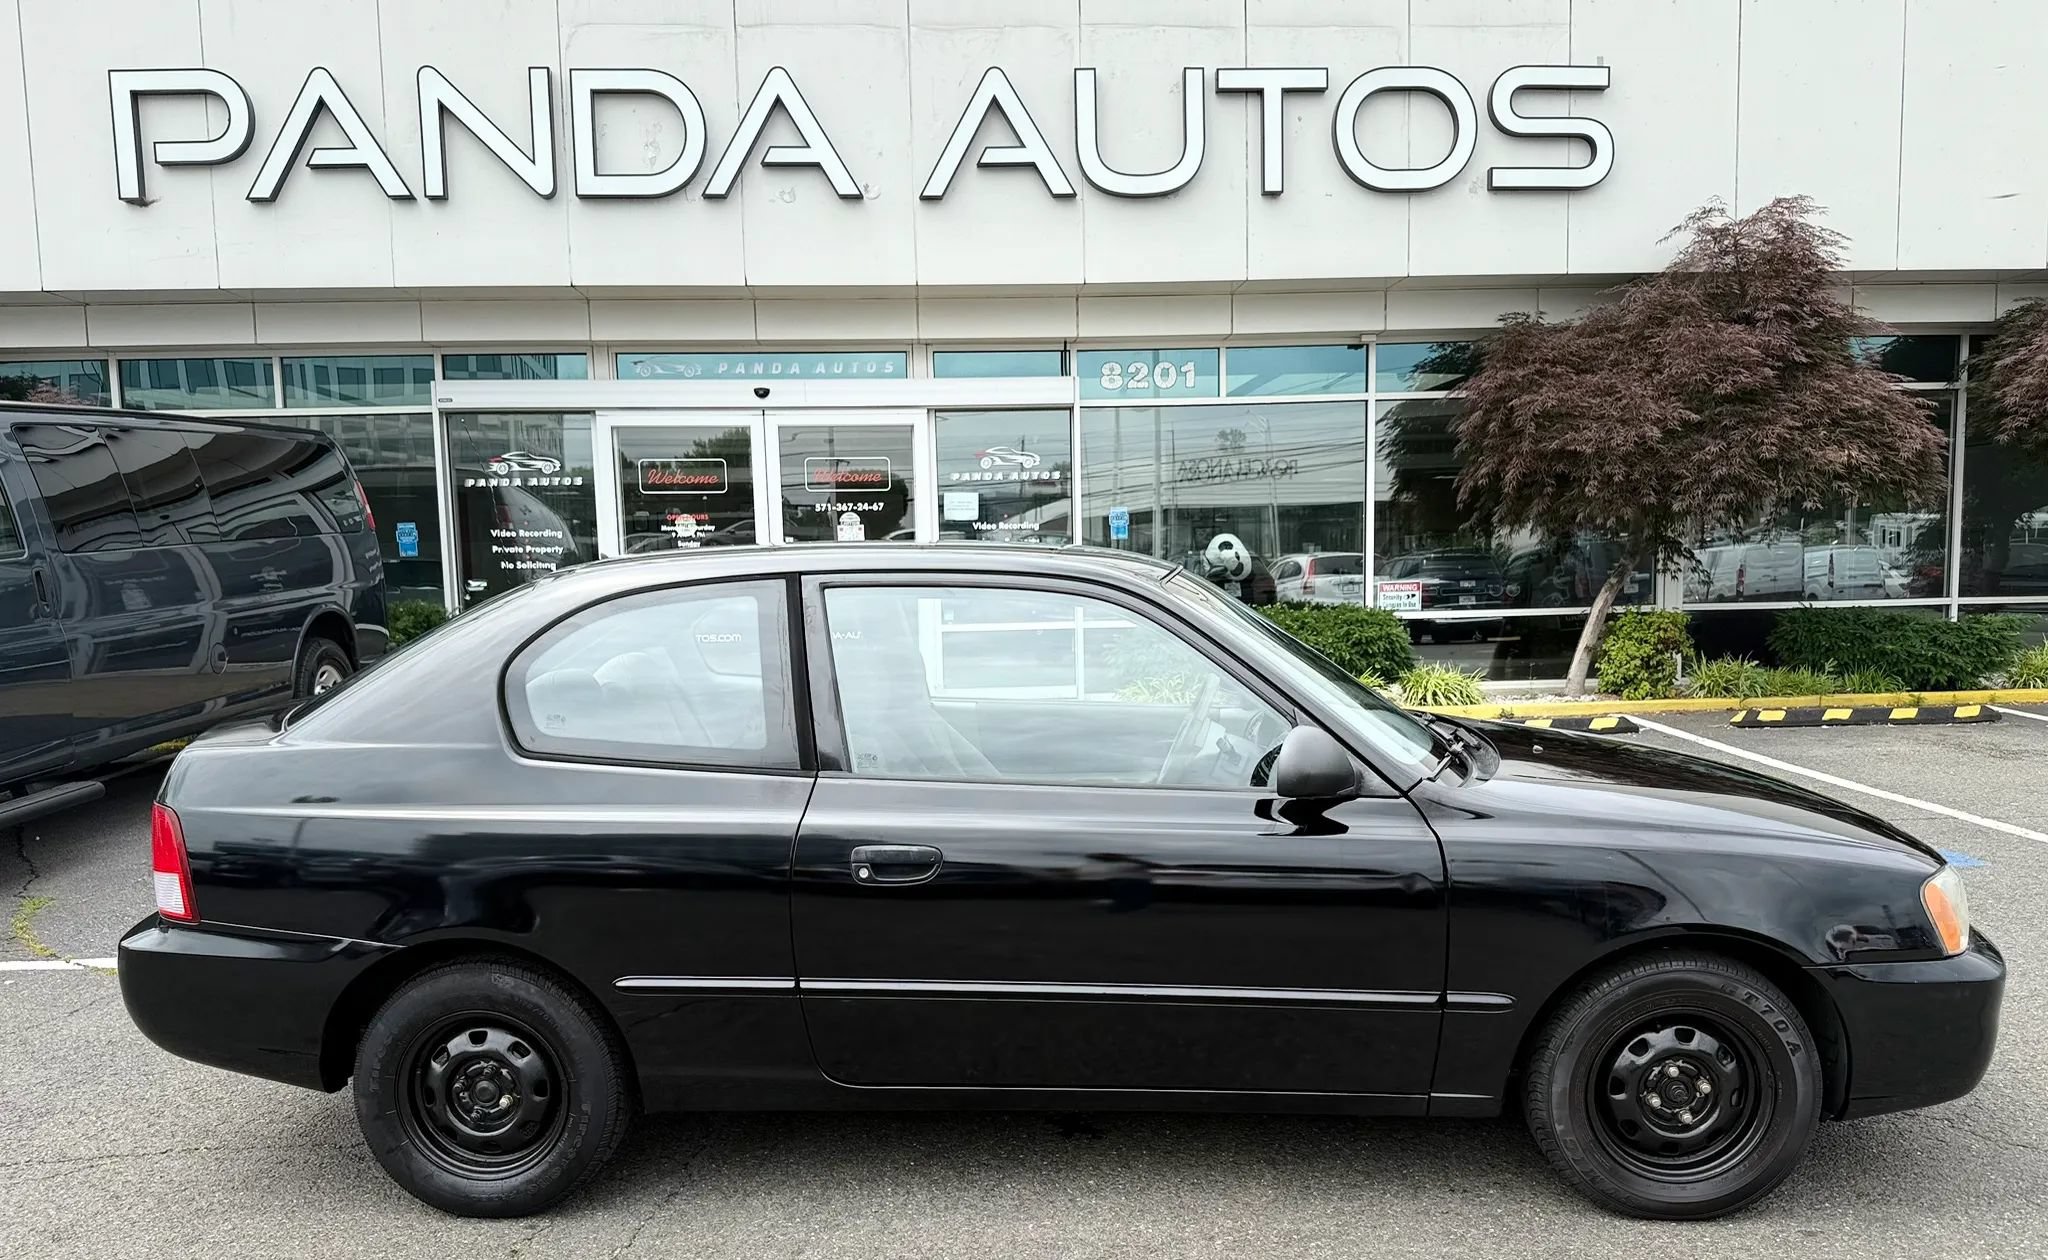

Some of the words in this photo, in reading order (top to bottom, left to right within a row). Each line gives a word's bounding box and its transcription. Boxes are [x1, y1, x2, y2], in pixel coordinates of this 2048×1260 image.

[108, 66, 864, 202] PANDA
[919, 65, 1615, 200] AUTOS
[718, 362, 801, 375] PANDA
[815, 361, 894, 374] AUTOS
[1100, 361, 1196, 390] 8201
[648, 468, 719, 485] Welcome
[813, 467, 882, 483] Welcome
[951, 471, 1003, 480] PANDA
[1008, 471, 1061, 480] AUTOS
[464, 477, 522, 487] PANDA
[527, 476, 583, 486] AUTOS
[815, 502, 884, 512] 571-367-24-67
[973, 521, 997, 530] Video
[999, 521, 1040, 531] Recording
[490, 529, 517, 538] Video
[519, 529, 563, 539] Recording
[492, 545, 524, 554] Private
[526, 545, 564, 555] Property
[501, 561, 514, 569] No
[1382, 584, 1418, 592] WARNING
